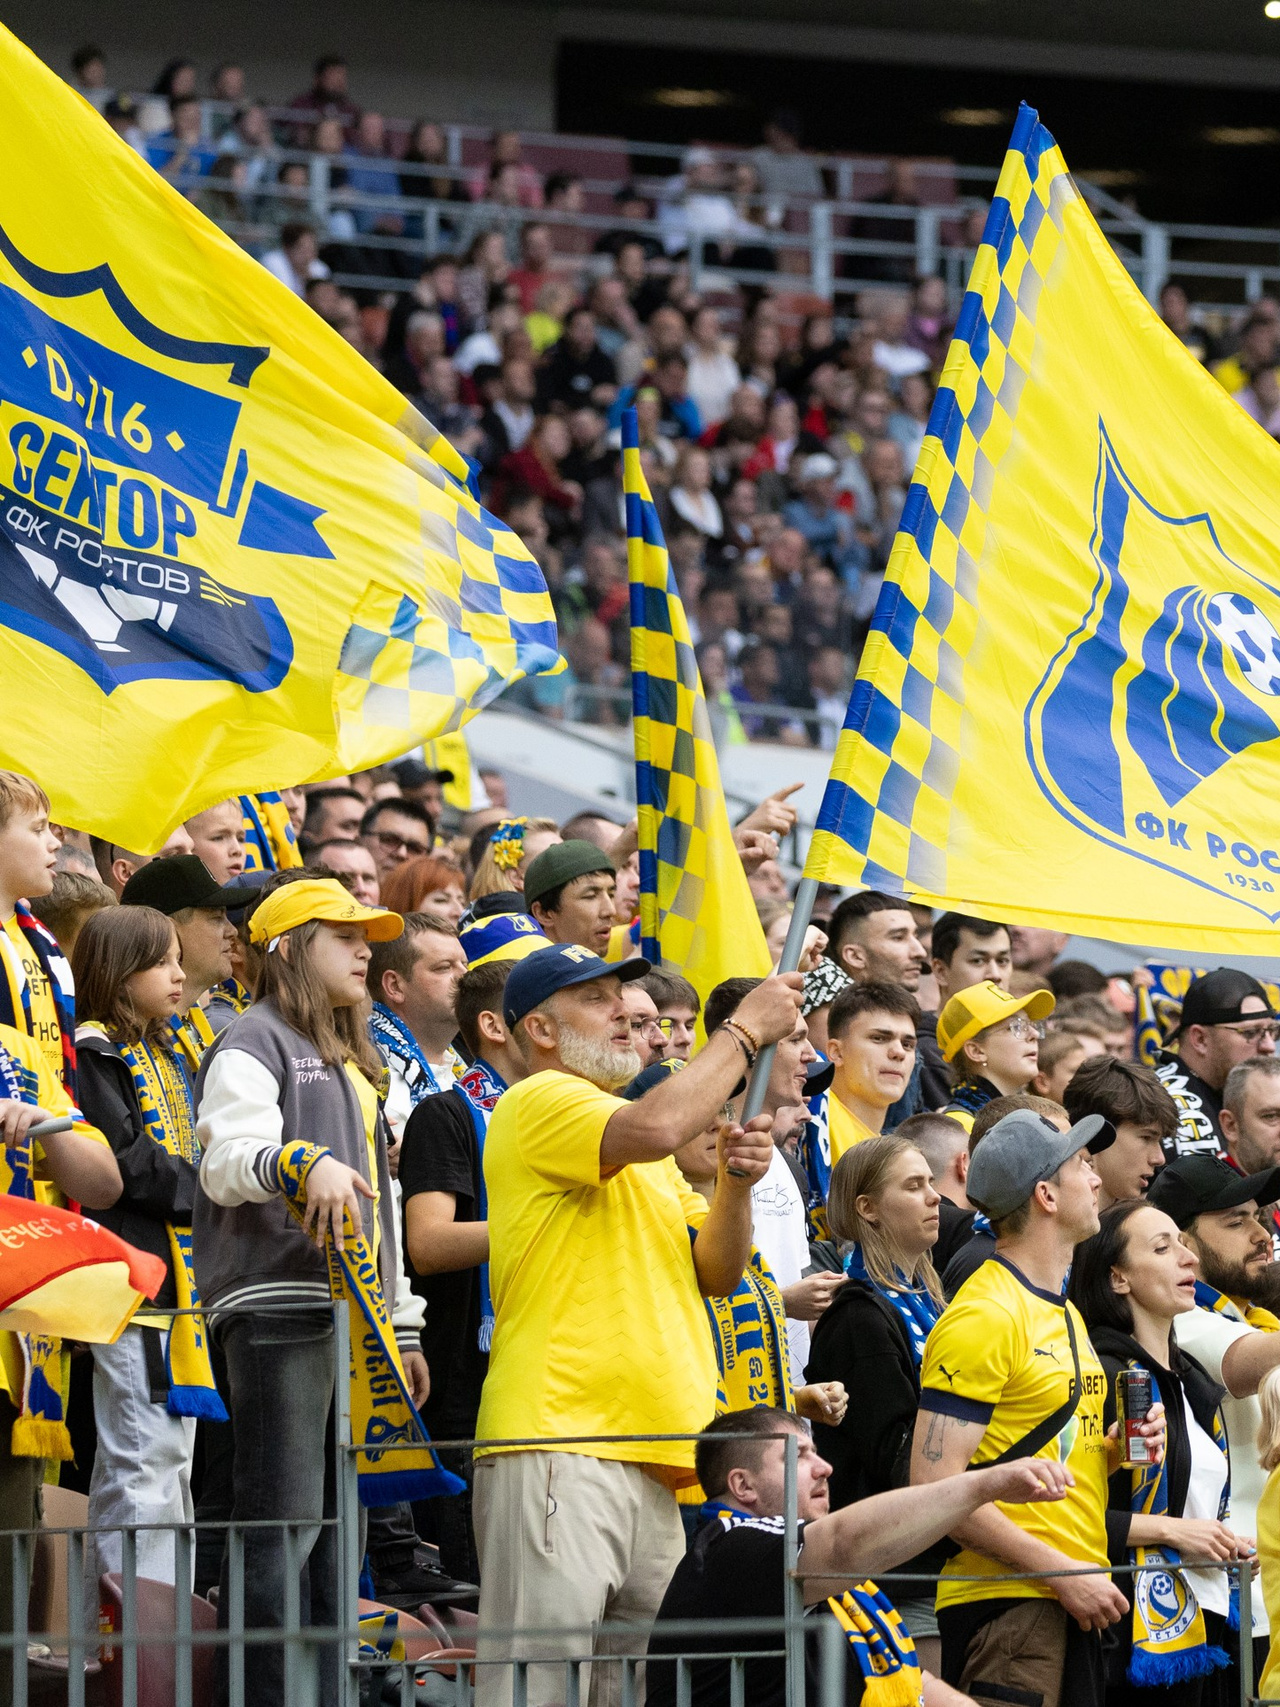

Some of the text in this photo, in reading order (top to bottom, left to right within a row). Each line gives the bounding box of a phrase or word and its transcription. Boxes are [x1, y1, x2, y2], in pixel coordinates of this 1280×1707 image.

[45, 343, 153, 454] D-116
[9, 420, 197, 558] СЕКТОР
[6, 504, 191, 595] ФК РОСТОВ
[1134, 809, 1191, 851] ФК
[1224, 871, 1275, 894] 1930
[291, 1057, 325, 1069] FEELIN
[295, 1069, 331, 1085] JOYFUL
[345, 1241, 388, 1325] 2025
[720, 1319, 736, 1370] СЛОВО
